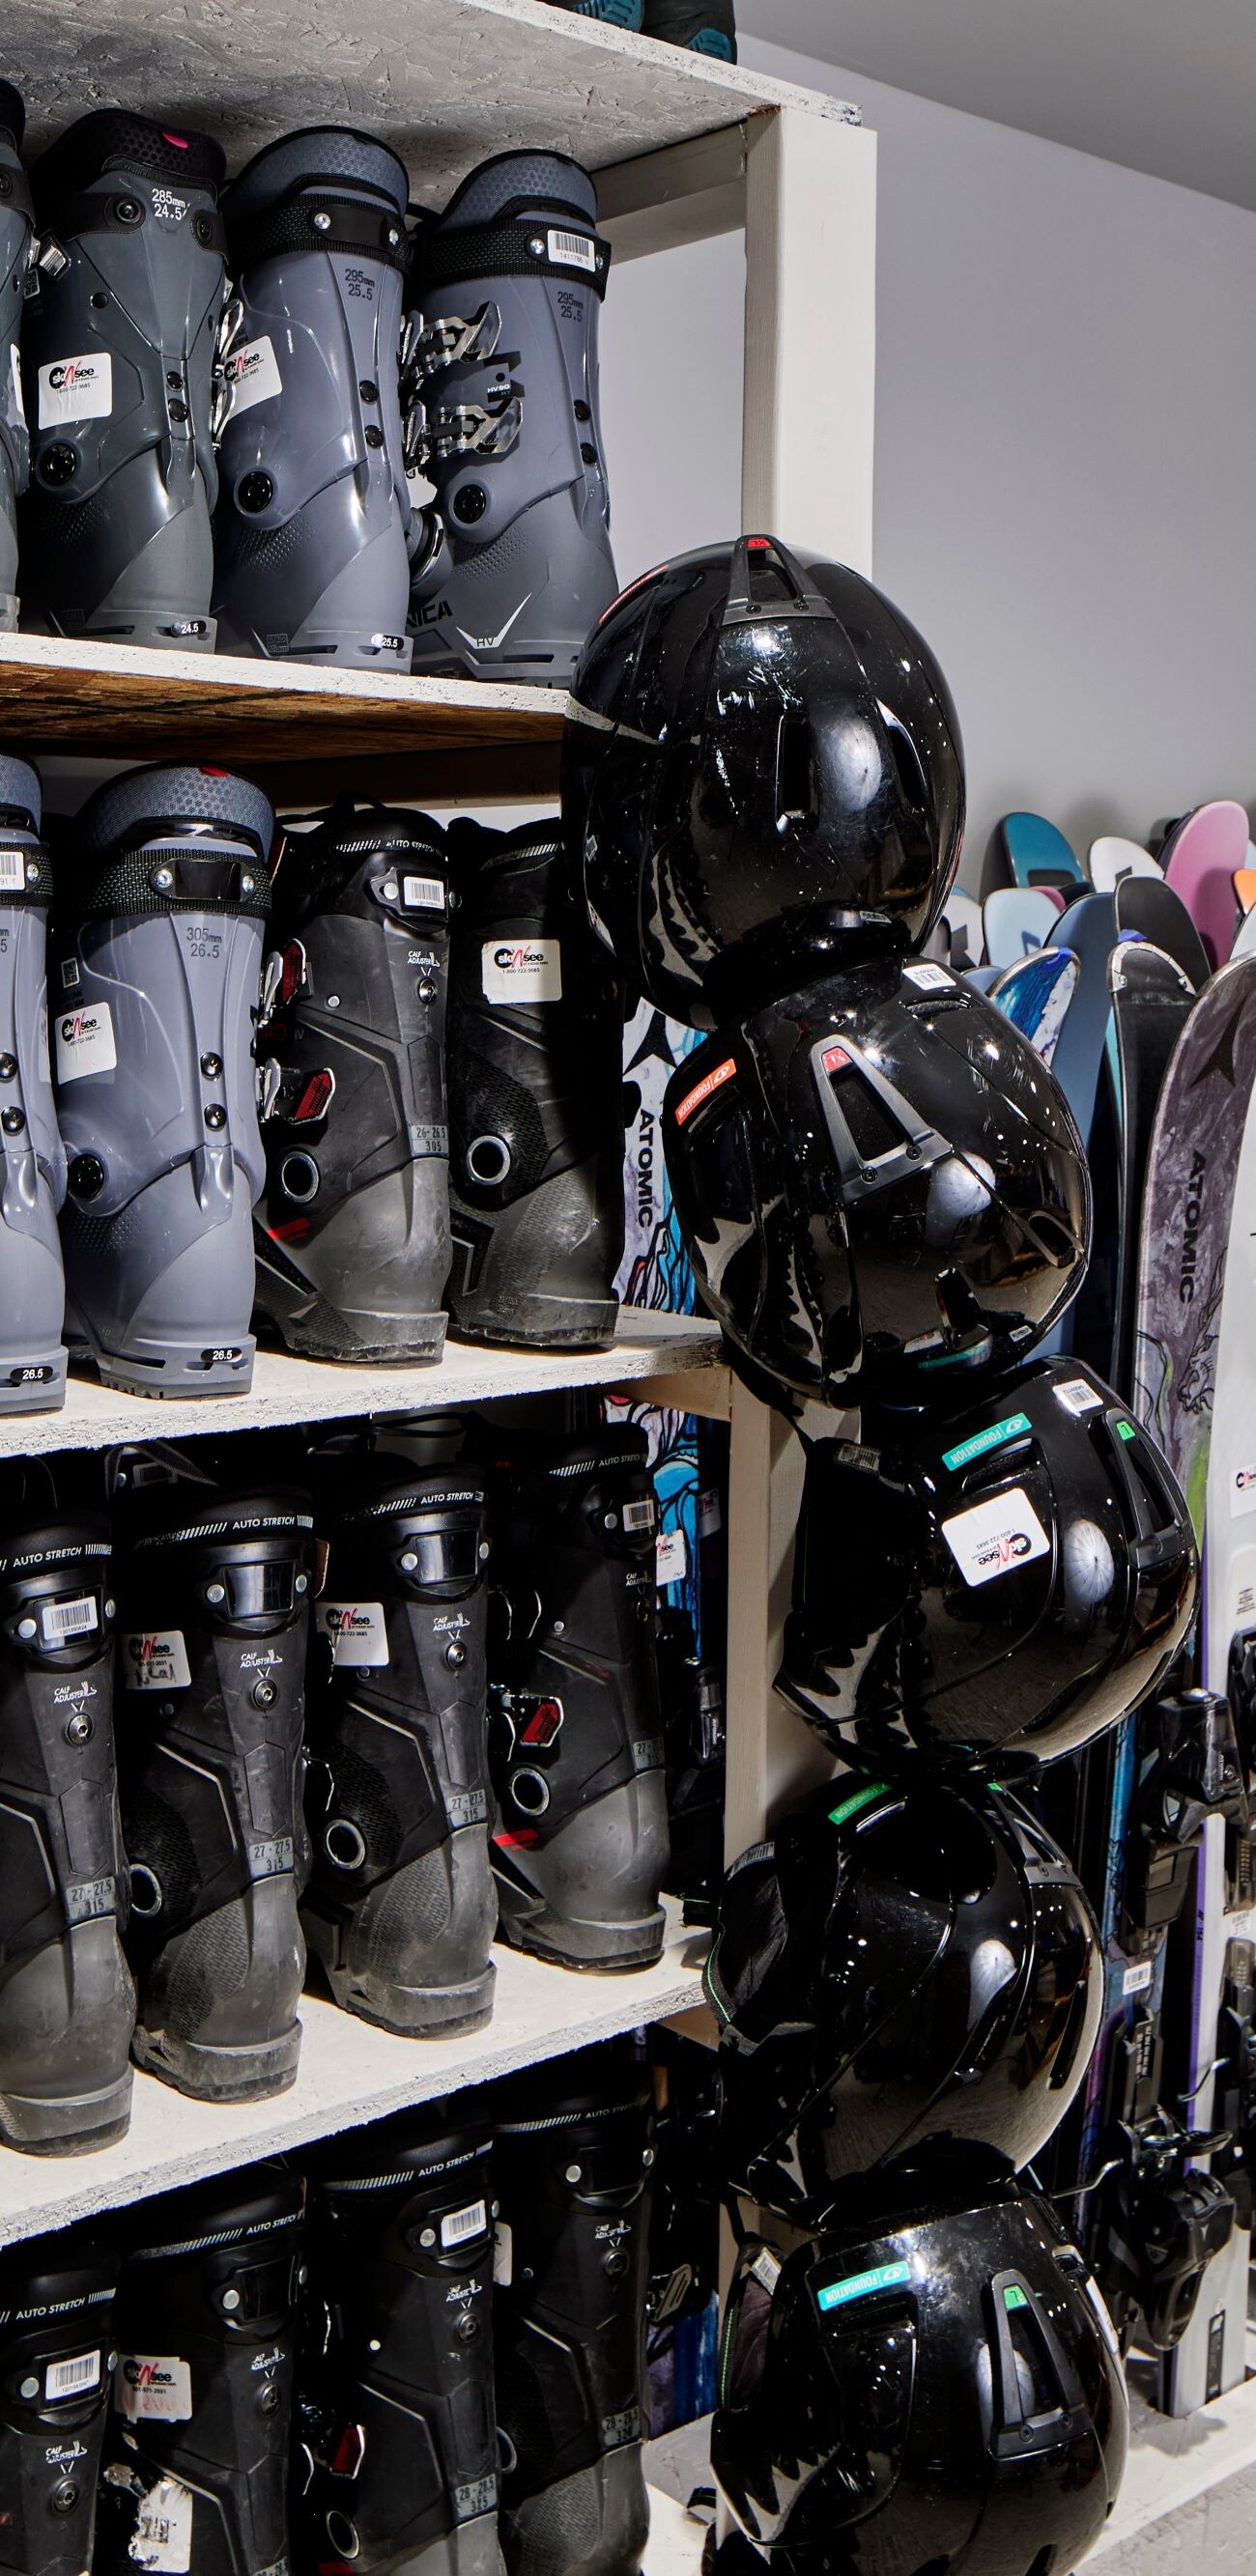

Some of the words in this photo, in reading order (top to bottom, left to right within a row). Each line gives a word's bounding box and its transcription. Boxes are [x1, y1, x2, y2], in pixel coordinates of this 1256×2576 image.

[154, 204, 183, 221] 24.5
[348, 283, 373, 300] 25.5
[560, 305, 582, 323] 25.5
[181, 623, 199, 635] 24.5
[382, 637, 398, 648] 25.5
[476, 637, 495, 648] HV
[186, 927, 222, 944] 305mm
[190, 943, 219, 958] 26.5
[677, 1081, 711, 1119] FOUNDATION
[425, 1141, 442, 1152] 305
[638, 1109, 655, 1230] ATOMIC
[1178, 1149, 1206, 1305] ATOMIC
[213, 1349, 232, 1361] 26.5
[22, 1368, 44, 1380] 26.5
[950, 1430, 1003, 1465] FOUNDATION
[599, 1457, 619, 1467] AUTO
[420, 1494, 444, 1505] AUTO
[446, 1491, 474, 1503] STRETCH
[232, 1517, 261, 1530] AUTO
[262, 1515, 295, 1527] STRETCH
[13, 1553, 43, 1568] AUTO
[45, 1547, 82, 1562] STRETCH
[451, 1798, 463, 1810] 27
[464, 1807, 479, 1823] 315
[254, 1845, 266, 1859] 27
[274, 1839, 291, 1854] 27.5
[266, 1854, 284, 1872] 315
[71, 1887, 84, 1903] 27
[94, 1879, 112, 1898] 27.5
[85, 1897, 104, 1915] 315
[585, 2109, 611, 2119] AUTO
[418, 2163, 444, 2177] AUTO
[445, 2151, 474, 2169] STRETCH
[246, 2223, 271, 2236] AUTO
[825, 2274, 878, 2305] FOUNDATION
[15, 2307, 46, 2320] AUTO
[49, 2297, 86, 2314] STRETCH
[459, 2487, 471, 2504] 28
